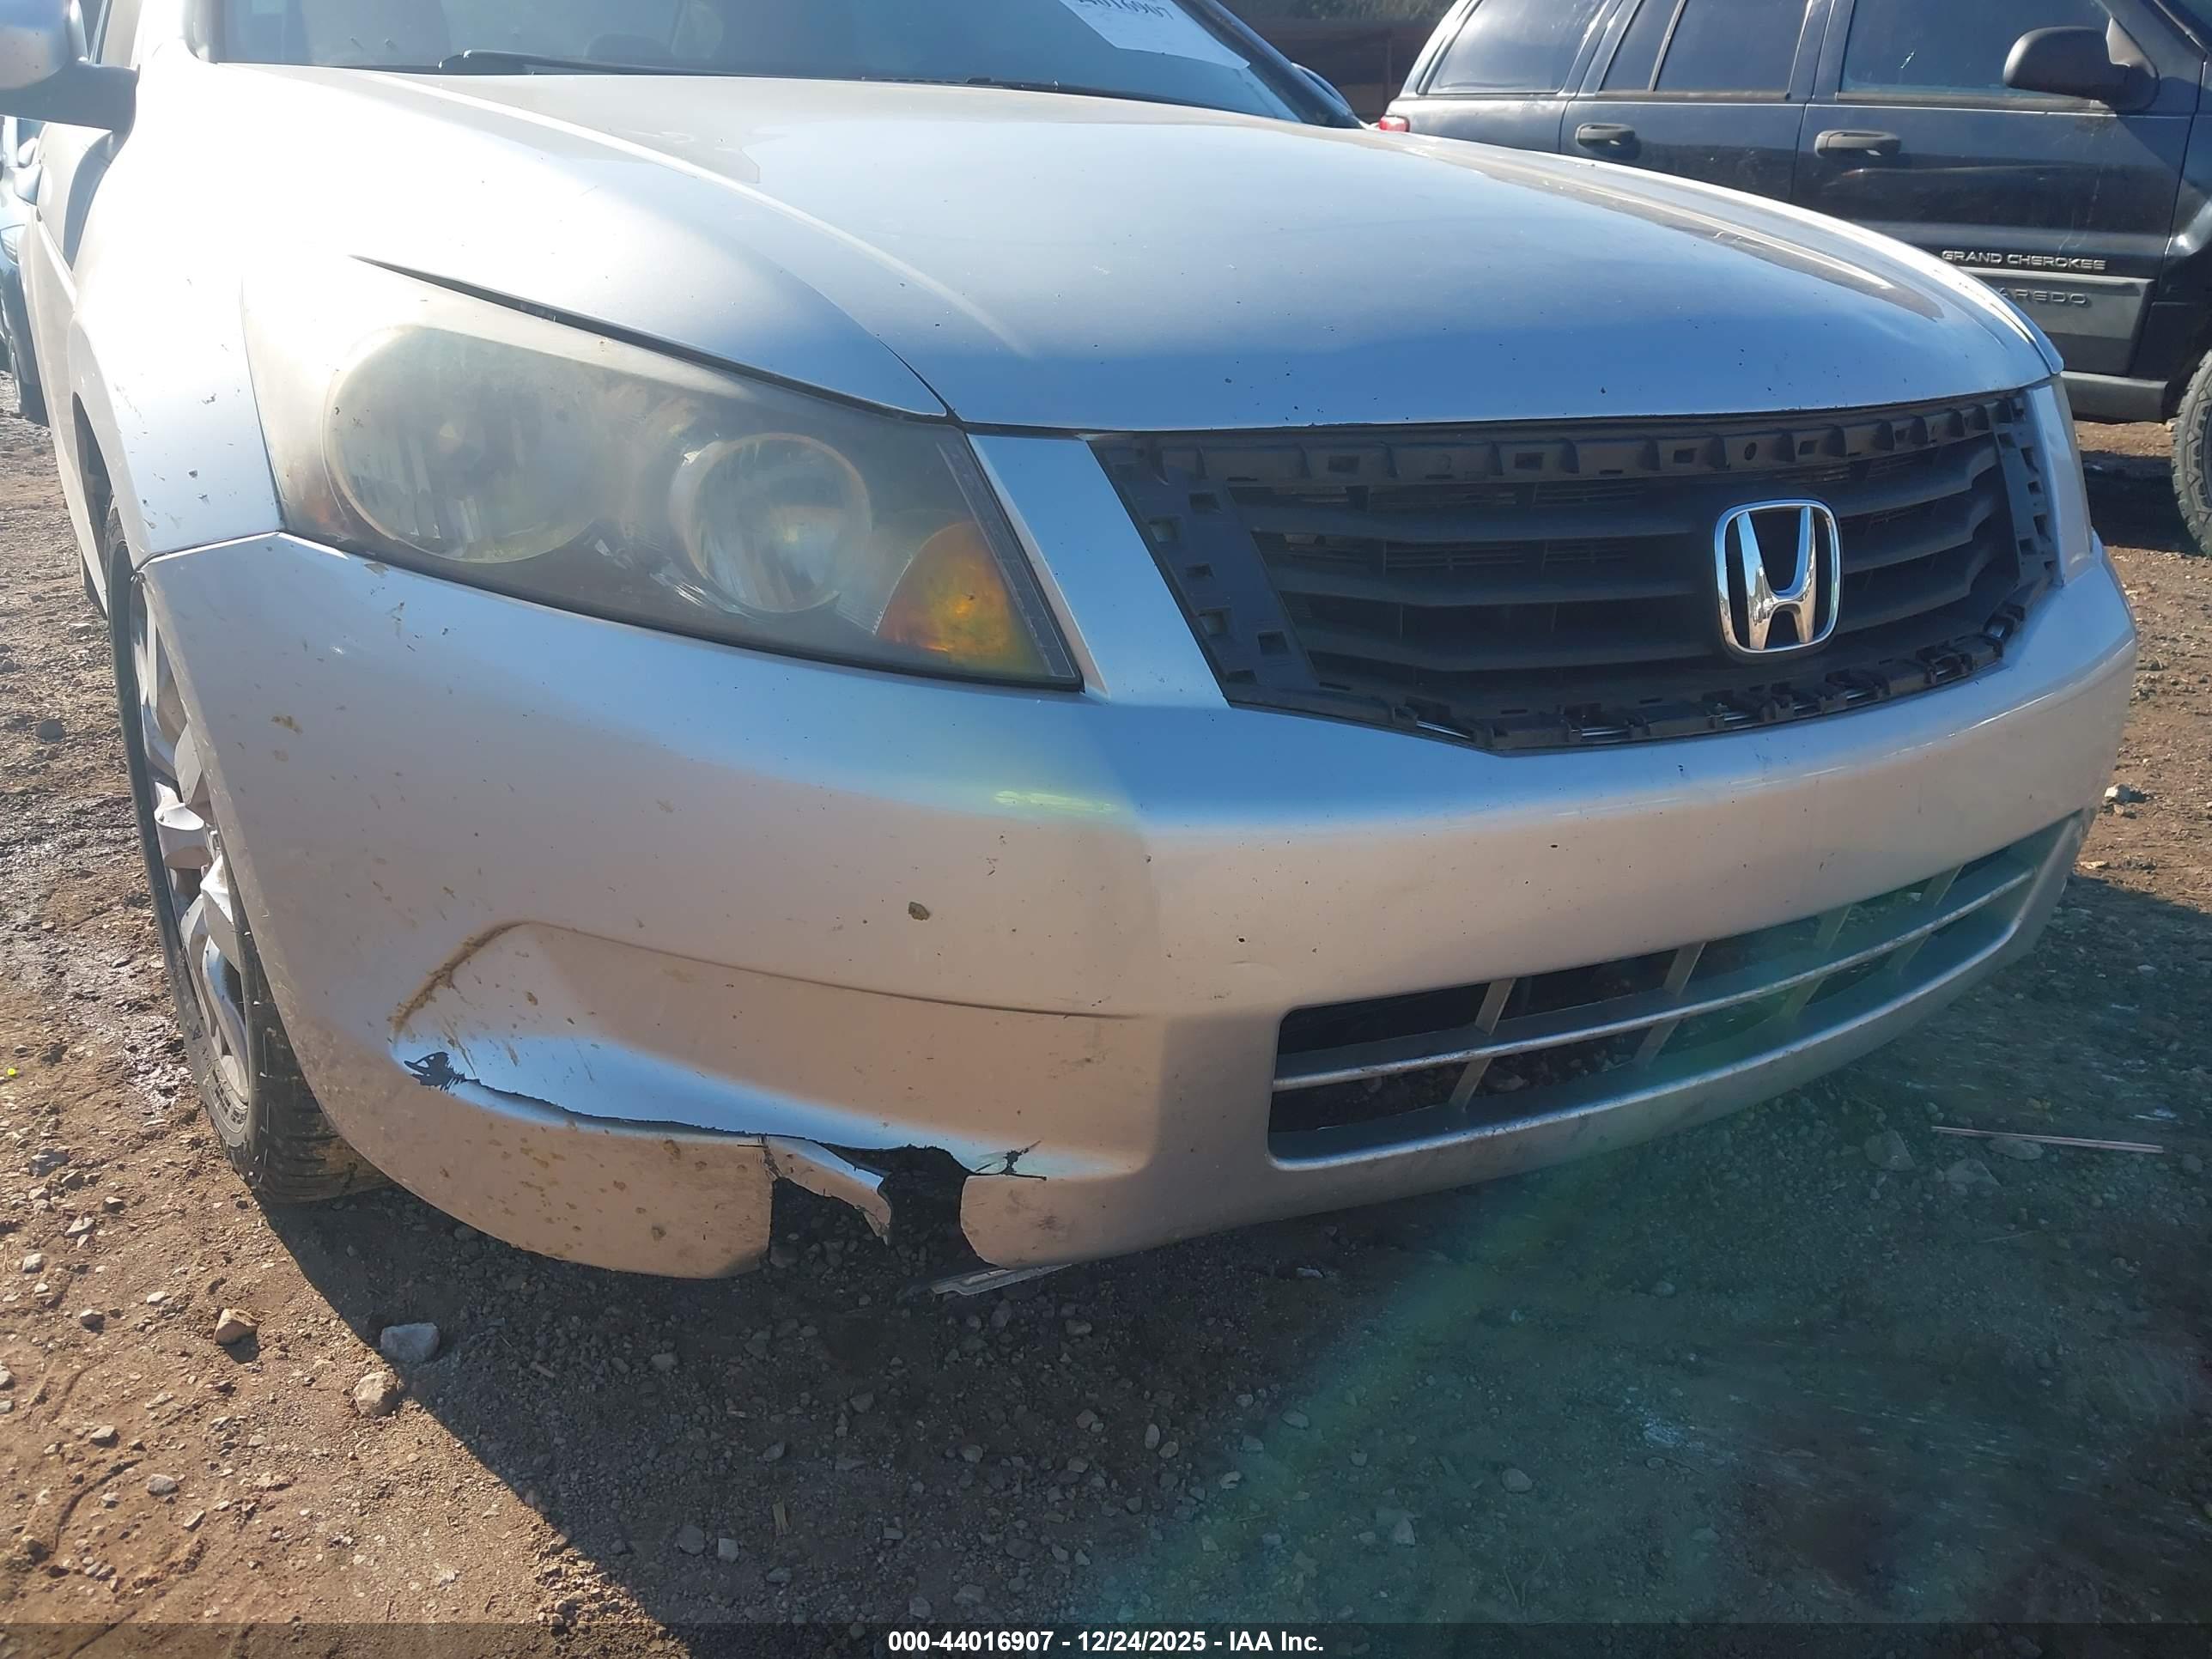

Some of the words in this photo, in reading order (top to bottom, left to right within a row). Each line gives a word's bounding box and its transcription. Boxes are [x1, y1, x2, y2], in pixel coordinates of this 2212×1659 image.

[1079, 0, 1174, 20] 016907
[1942, 250, 2002, 264] GRAND
[2007, 254, 2106, 270] CHEROKEE
[1998, 287, 2087, 304] AREDO
